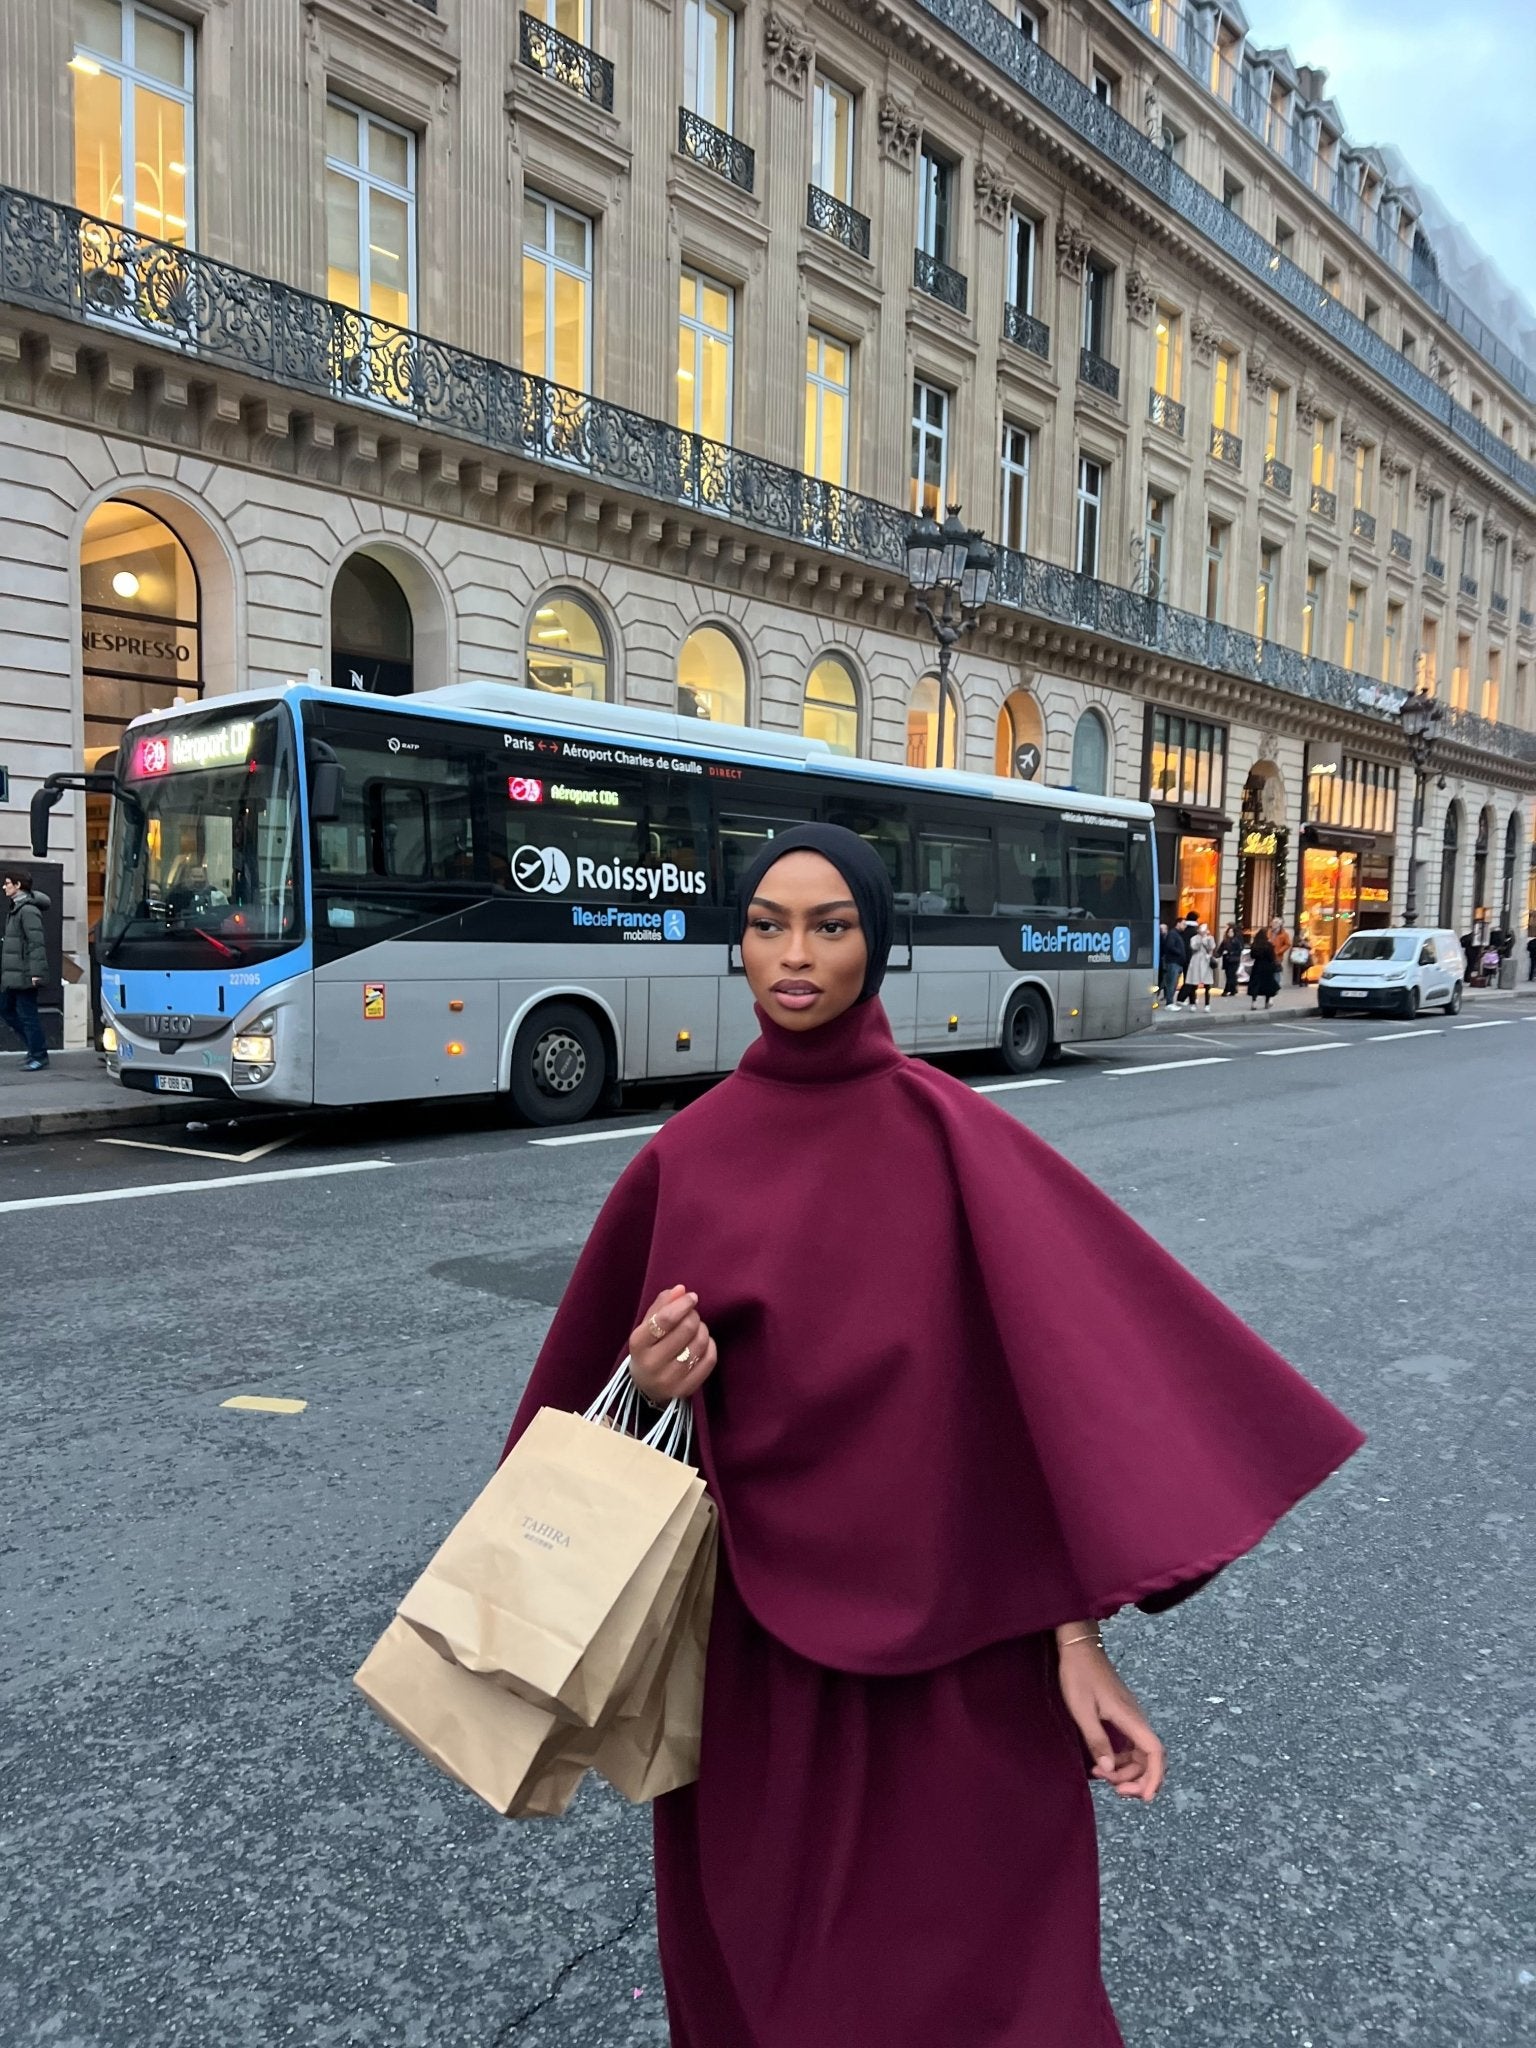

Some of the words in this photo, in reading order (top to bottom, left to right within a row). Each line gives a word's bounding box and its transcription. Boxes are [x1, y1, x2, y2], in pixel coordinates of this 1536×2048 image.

[401, 742, 420, 750] RATP
[503, 734, 535, 751] Paris
[562, 743, 613, 763] Aéroport
[614, 751, 654, 769] Charles
[656, 757, 669, 770] de
[671, 759, 703, 774] Gaulle
[709, 766, 743, 780] DIRECT
[551, 785, 599, 805] Aéroport
[599, 790, 619, 806] CDG
[576, 856, 707, 900] RoissyBus
[623, 929, 662, 941] mobilités
[229, 973, 261, 986] 227095
[144, 1015, 191, 1034] IVECO
[522, 1515, 570, 1548] TAHIRA
